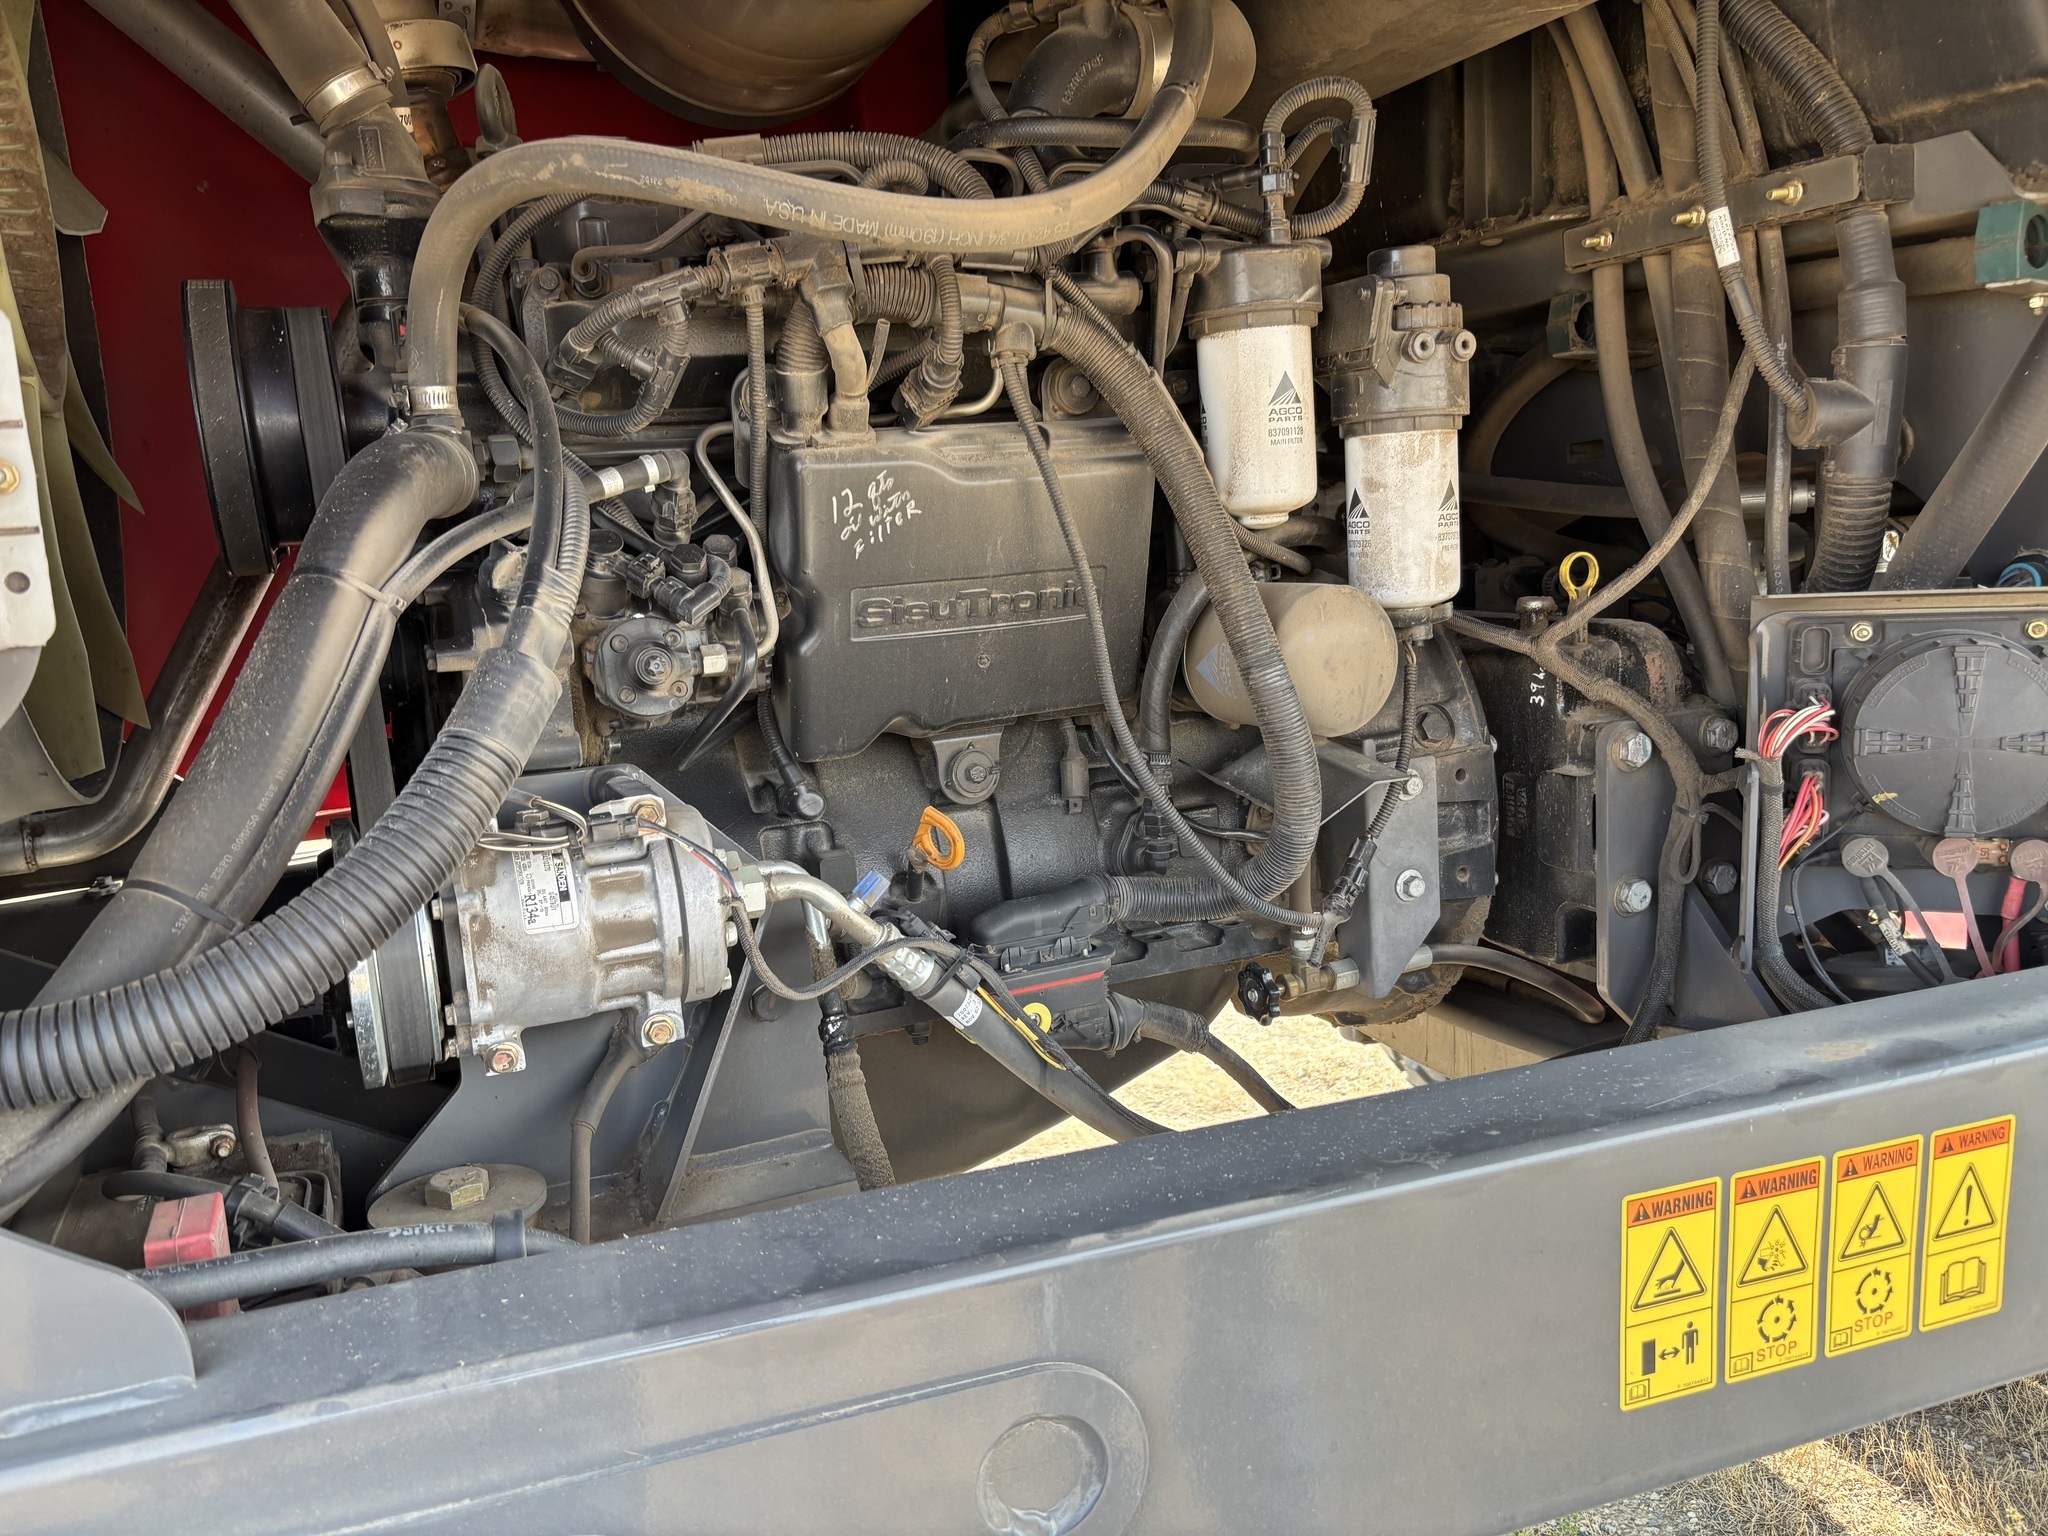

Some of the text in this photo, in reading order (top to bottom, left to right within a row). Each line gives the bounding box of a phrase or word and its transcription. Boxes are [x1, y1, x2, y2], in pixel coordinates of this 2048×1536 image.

[810, 208, 827, 229] IN
[834, 214, 879, 237] MADE
[947, 230, 983, 247] INCH
[1268, 406, 1303, 417] AGCO
[1268, 415, 1303, 424] PARTS
[1267, 426, 1304, 438] 837091128
[1269, 436, 1303, 447] MAIN FILTER
[831, 488, 864, 525] 12
[1348, 520, 1371, 529] AGCO
[1529, 682, 1546, 708] 39
[255, 782, 279, 812] MADE
[554, 861, 569, 892] SANDEN
[523, 894, 541, 926] R134a
[1958, 1126, 2006, 1150] WARNING
[1862, 1146, 1913, 1172] WARNING
[1758, 1169, 1818, 1197] WARNING
[1651, 1190, 1714, 1218] WARNING
[1854, 1311, 1895, 1333] STOP
[1756, 1340, 1799, 1363] STOP
